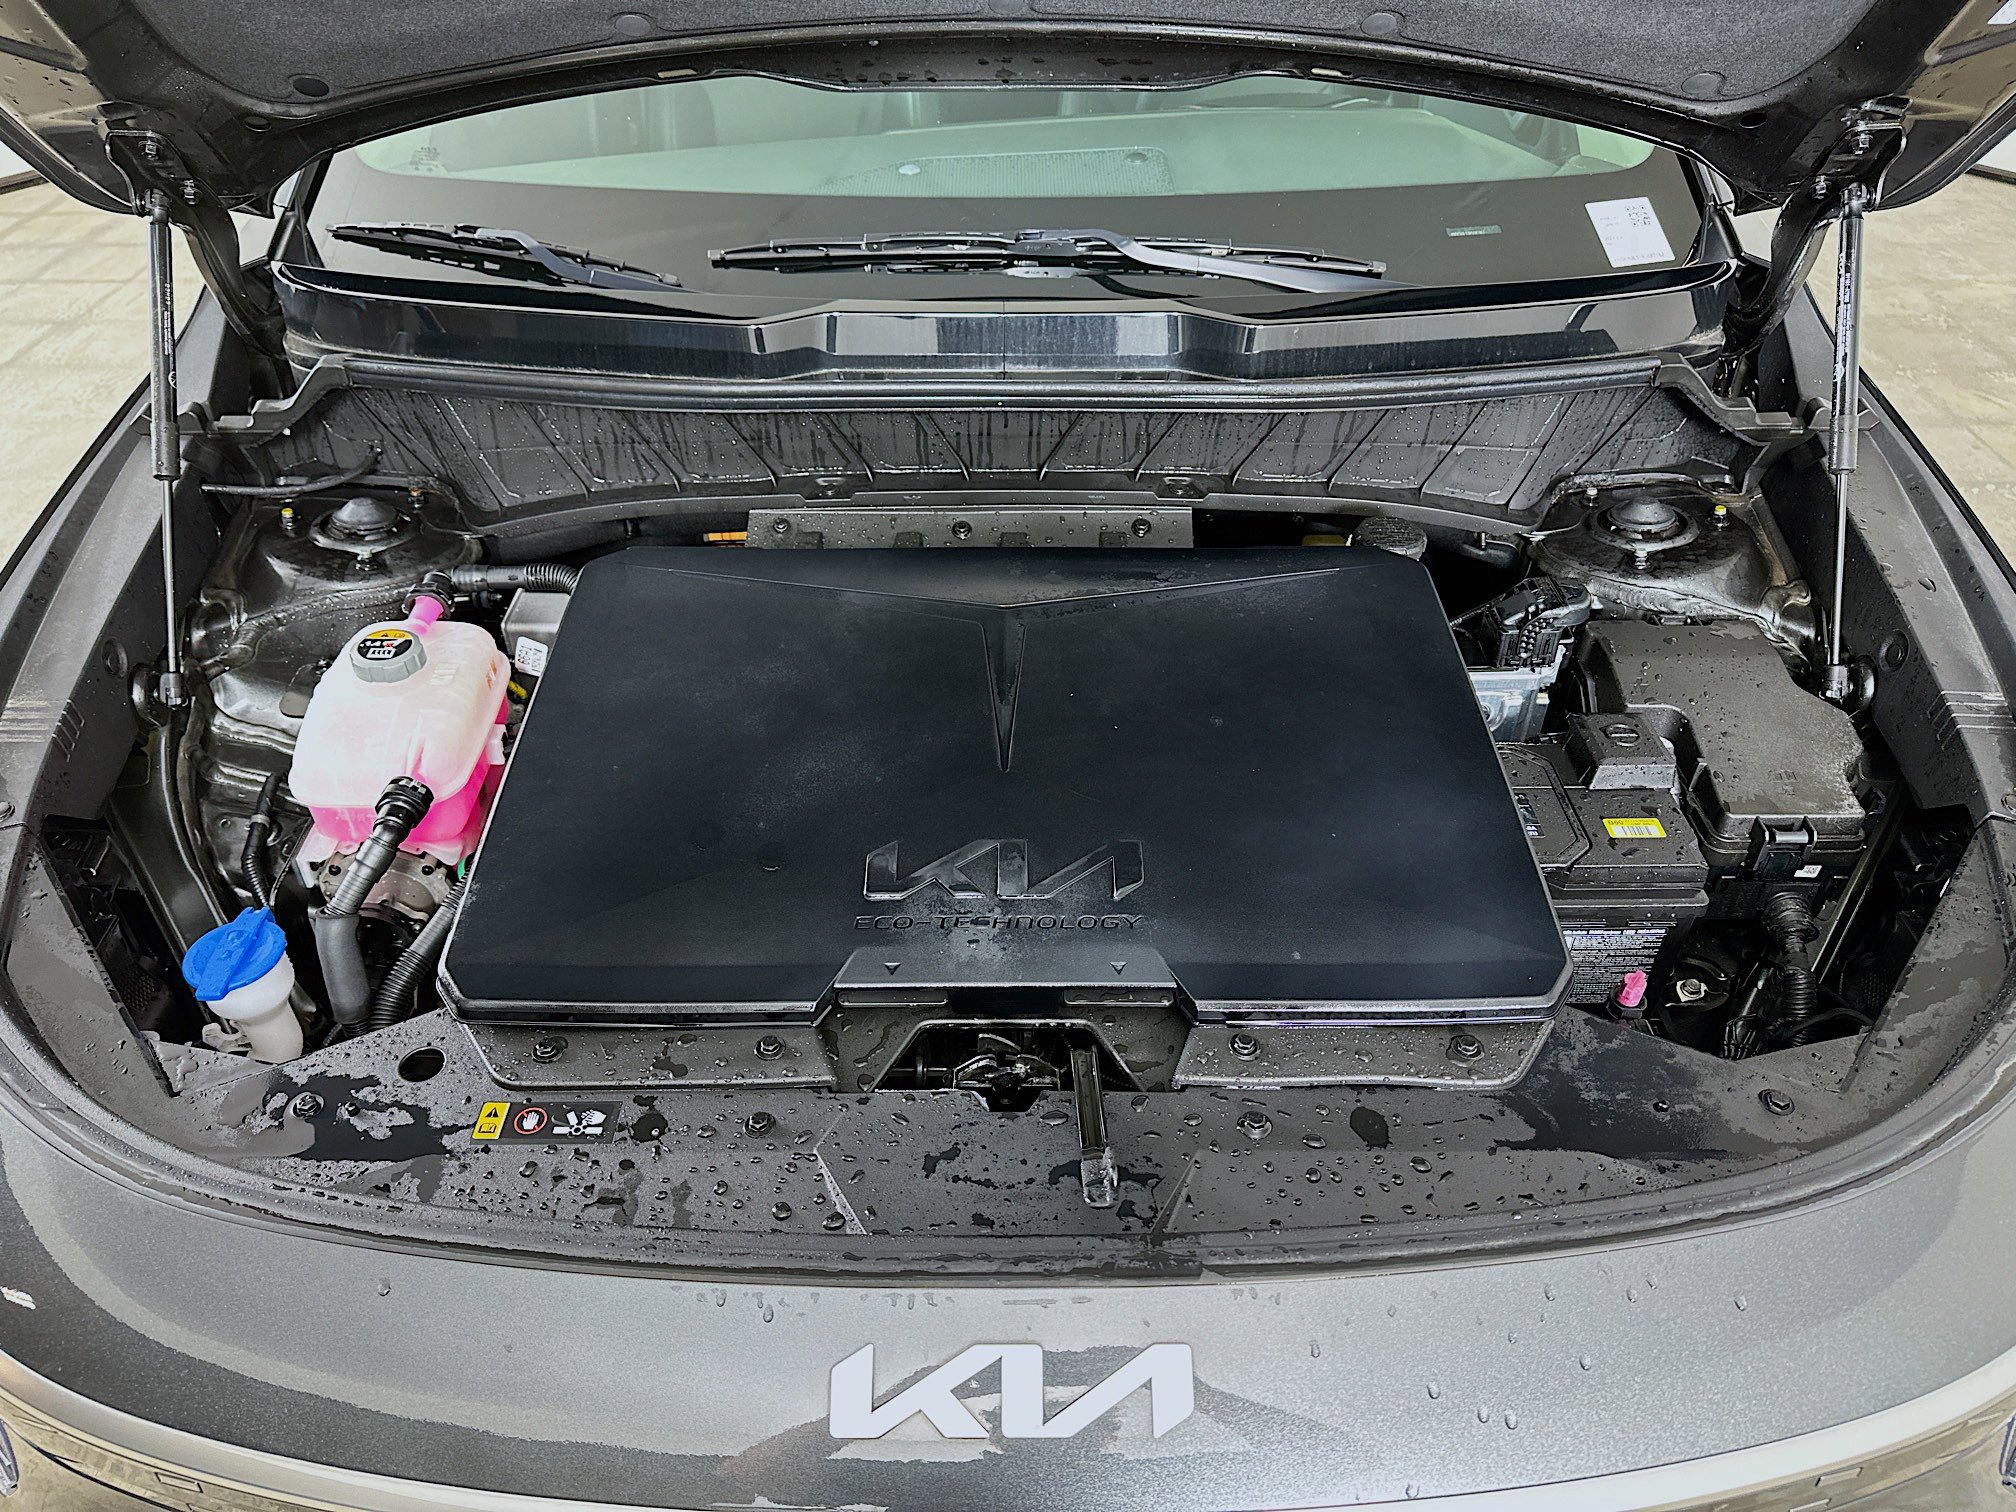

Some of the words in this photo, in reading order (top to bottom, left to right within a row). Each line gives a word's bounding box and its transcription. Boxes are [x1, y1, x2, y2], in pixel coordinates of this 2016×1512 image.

[863, 839, 1145, 901] KIA
[854, 914, 1144, 930] ECO-TECHNOLOGY
[829, 1343, 1195, 1439] KIA
